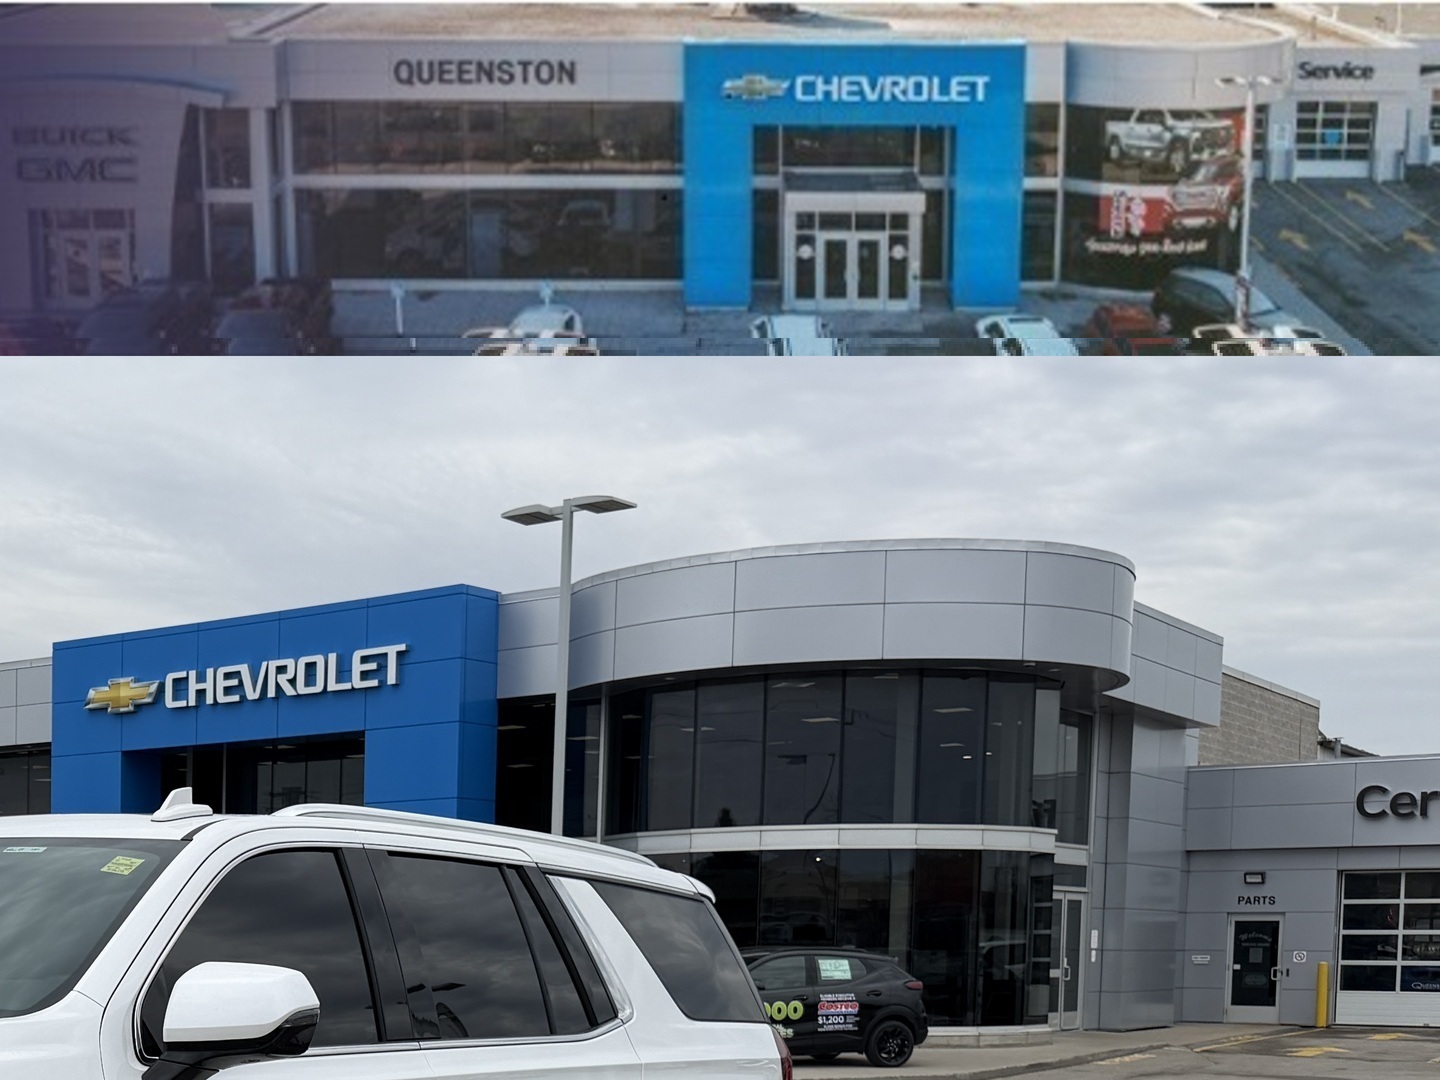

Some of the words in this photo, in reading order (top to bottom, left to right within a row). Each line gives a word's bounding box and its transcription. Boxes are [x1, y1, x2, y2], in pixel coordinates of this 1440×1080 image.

[164, 642, 409, 710] CHEVROLET
[1237, 895, 1276, 905] PARTS
[817, 1015, 845, 1024] $1,200
